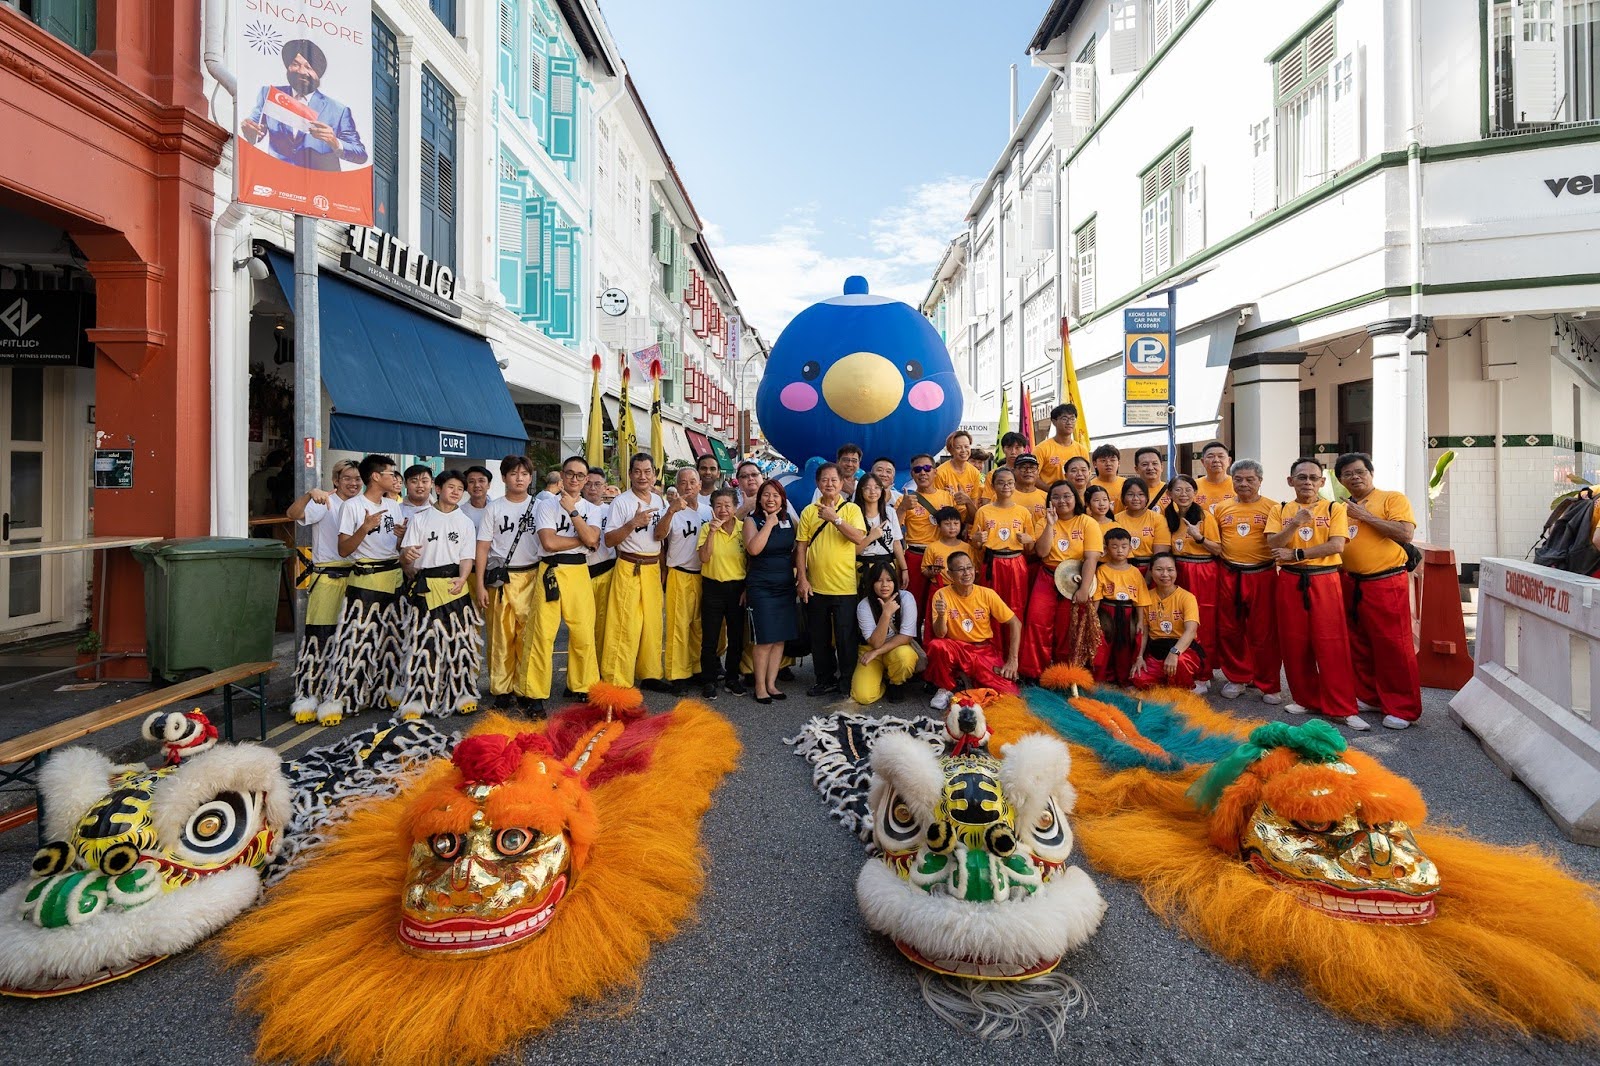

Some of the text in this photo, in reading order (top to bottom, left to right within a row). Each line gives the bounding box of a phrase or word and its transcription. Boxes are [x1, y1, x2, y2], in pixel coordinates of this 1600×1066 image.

[246, 0, 363, 45] SINGAPORE
[368, 266, 391, 282] PERSONAL
[391, 277, 412, 292] TRAINING
[414, 288, 430, 300] FITNESS
[442, 438, 464, 449] CURE
[1543, 585, 1557, 609] PTE.
[1557, 590, 1571, 614] LTD.
